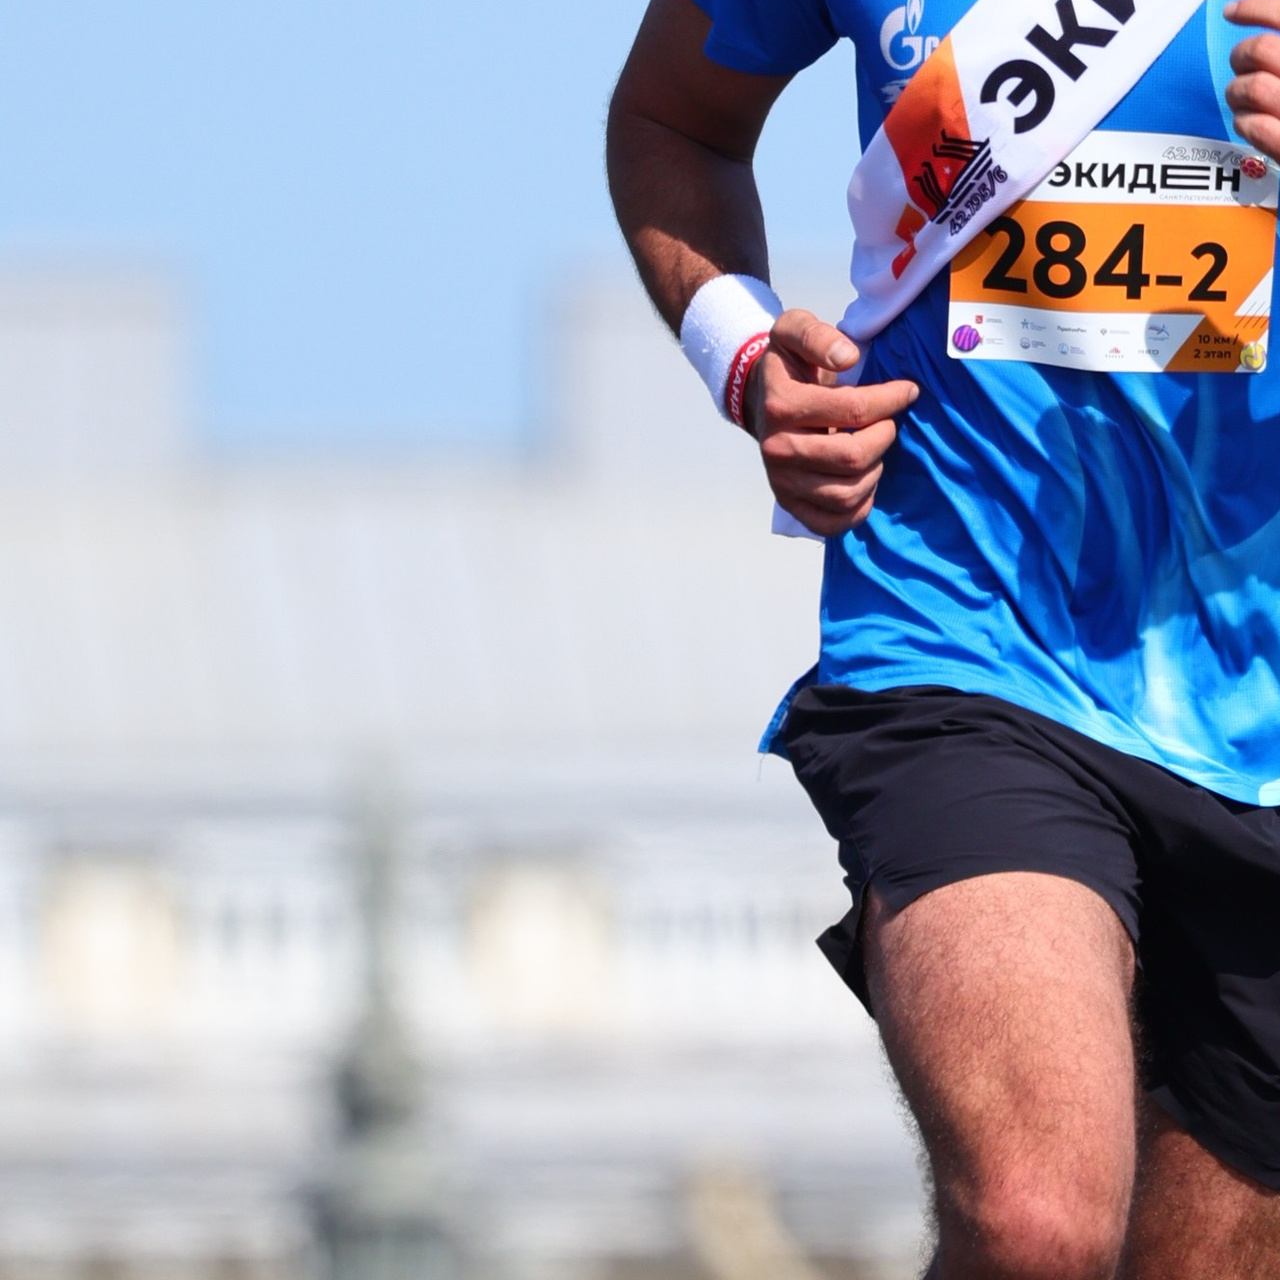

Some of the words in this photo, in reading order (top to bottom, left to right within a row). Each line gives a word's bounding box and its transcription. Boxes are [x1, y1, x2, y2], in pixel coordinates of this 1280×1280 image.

[1047, 161, 1241, 195] ЭКИДЕН
[982, 215, 1228, 302] 284-2
[1198, 334, 1211, 345] 10
[1214, 336, 1231, 345] км
[1193, 348, 1201, 359] 2
[1203, 349, 1231, 360] этап
